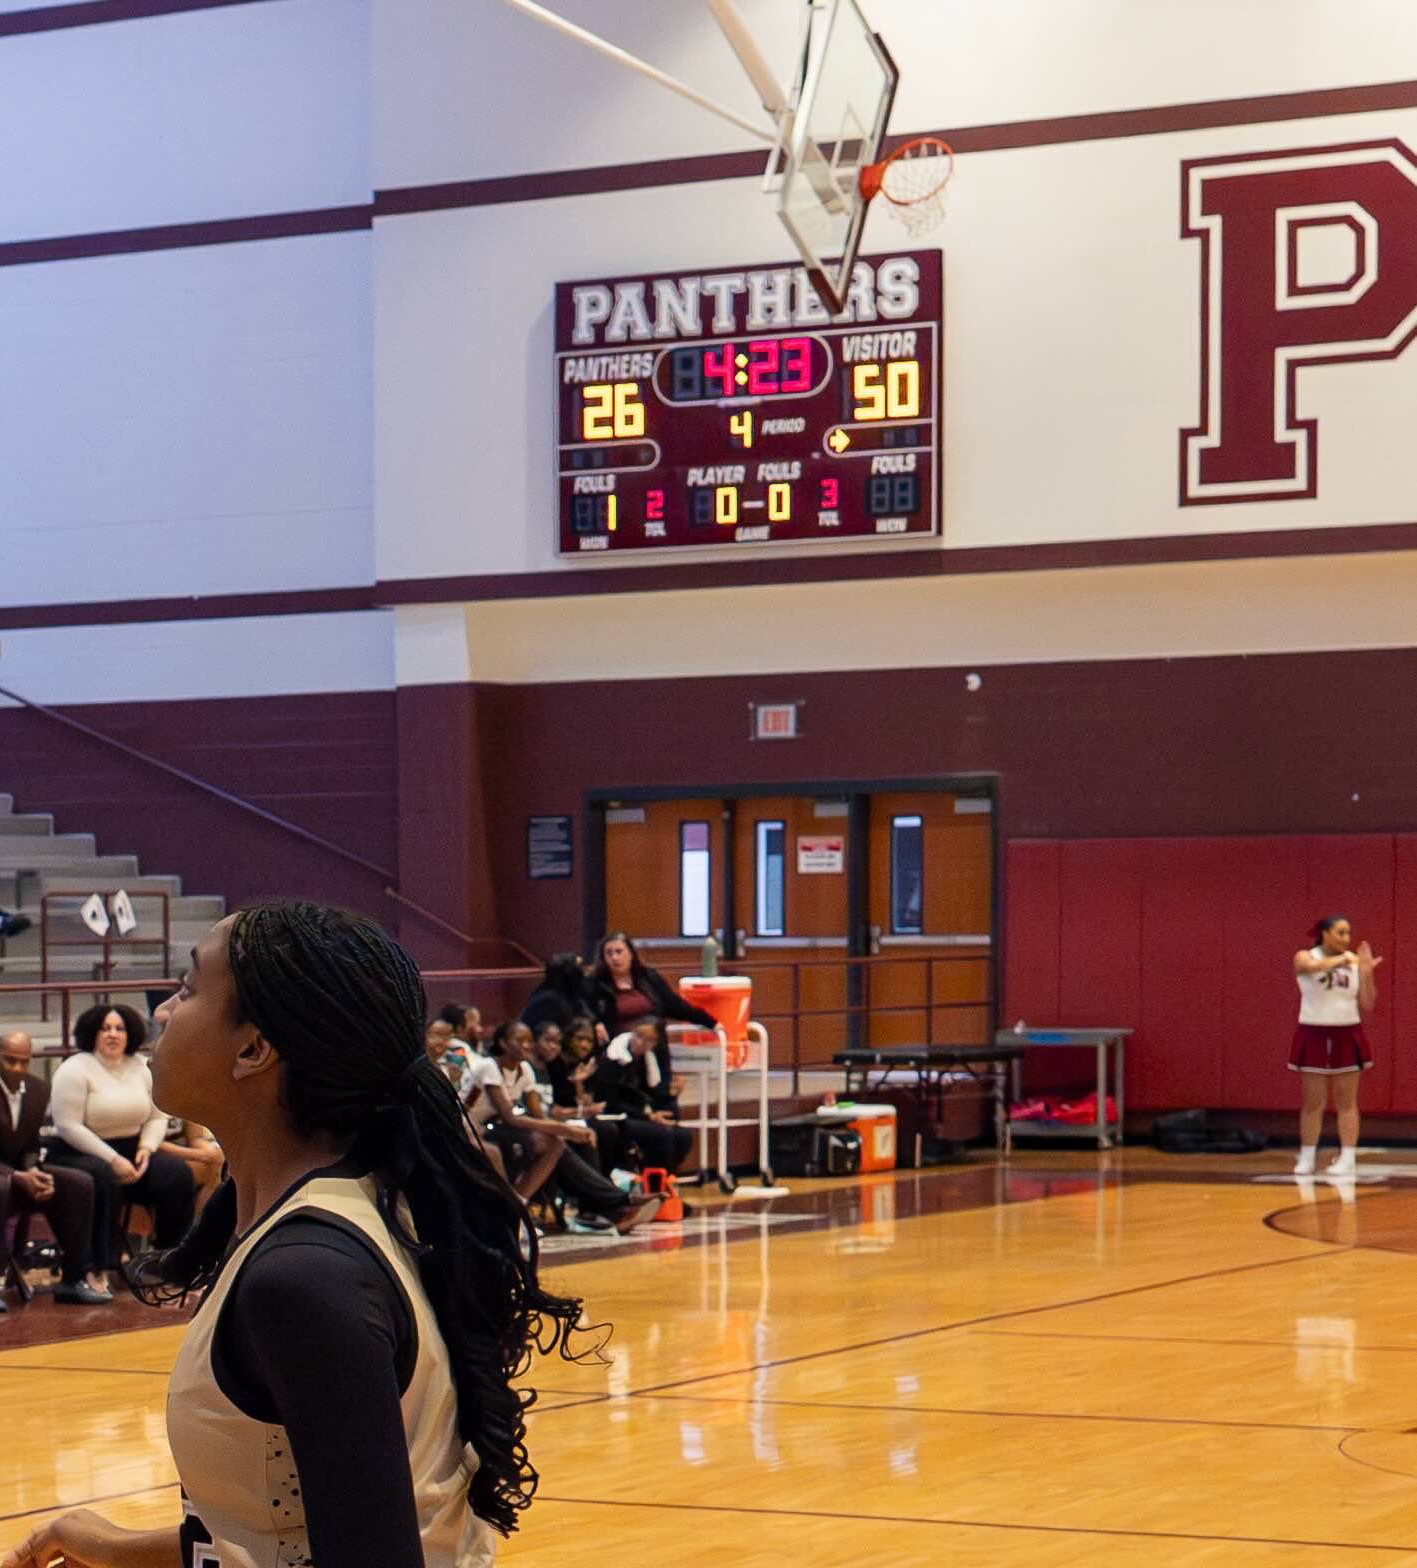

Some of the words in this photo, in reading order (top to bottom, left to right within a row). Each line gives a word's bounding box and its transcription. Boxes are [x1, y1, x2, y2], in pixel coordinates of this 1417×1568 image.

[572, 257, 919, 344] PANTHERS
[1178, 137, 1417, 508] P
[842, 332, 917, 362] VISITOR
[564, 353, 655, 384] PANTHERS
[703, 337, 811, 397] 4:23
[854, 360, 919, 420] 50
[583, 382, 644, 439] 26
[761, 417, 806, 435] PERIOD
[730, 411, 752, 448] 4
[687, 465, 746, 487] PLAYER
[757, 461, 801, 482] FOULS
[871, 453, 917, 474] FOULS
[574, 474, 616, 494] FOULS
[820, 478, 838, 509] 3
[607, 494, 616, 531] 1
[646, 489, 664, 519] 2
